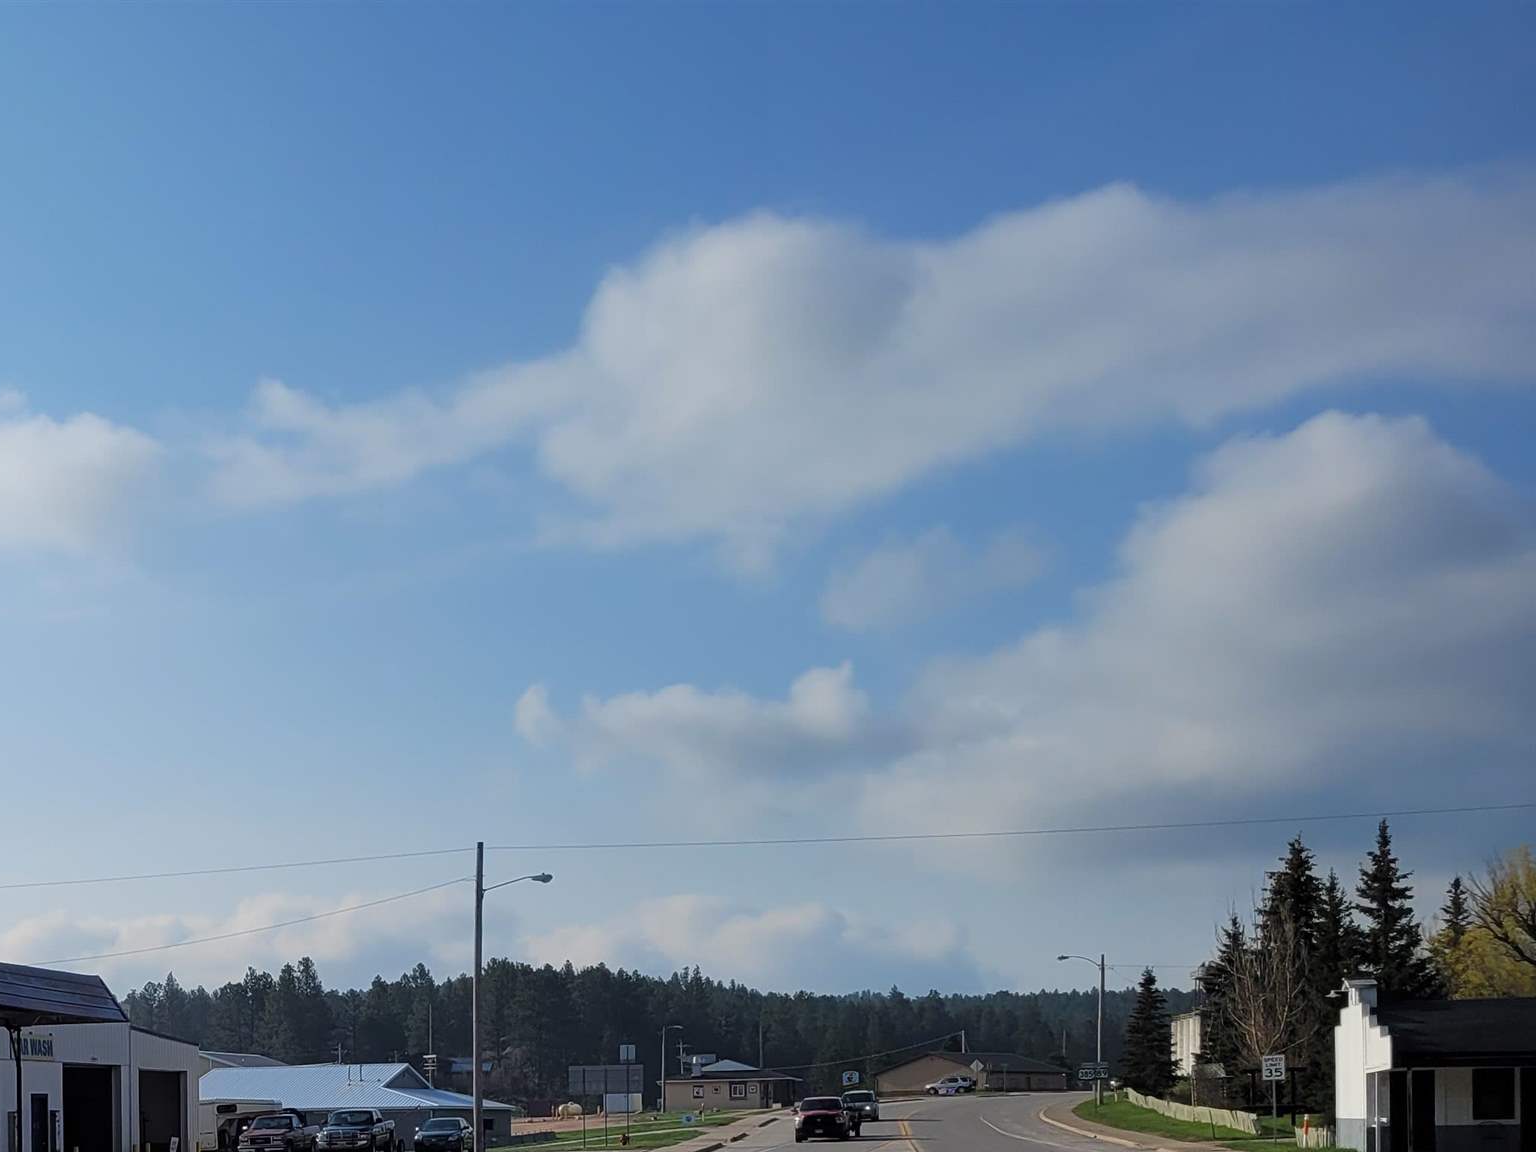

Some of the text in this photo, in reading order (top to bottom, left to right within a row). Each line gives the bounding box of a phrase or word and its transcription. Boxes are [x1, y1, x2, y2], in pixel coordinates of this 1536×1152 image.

[30, 1038, 53, 1057] WASH
[1080, 1070, 1094, 1078] 385
[1265, 1067, 1283, 1077] 35
